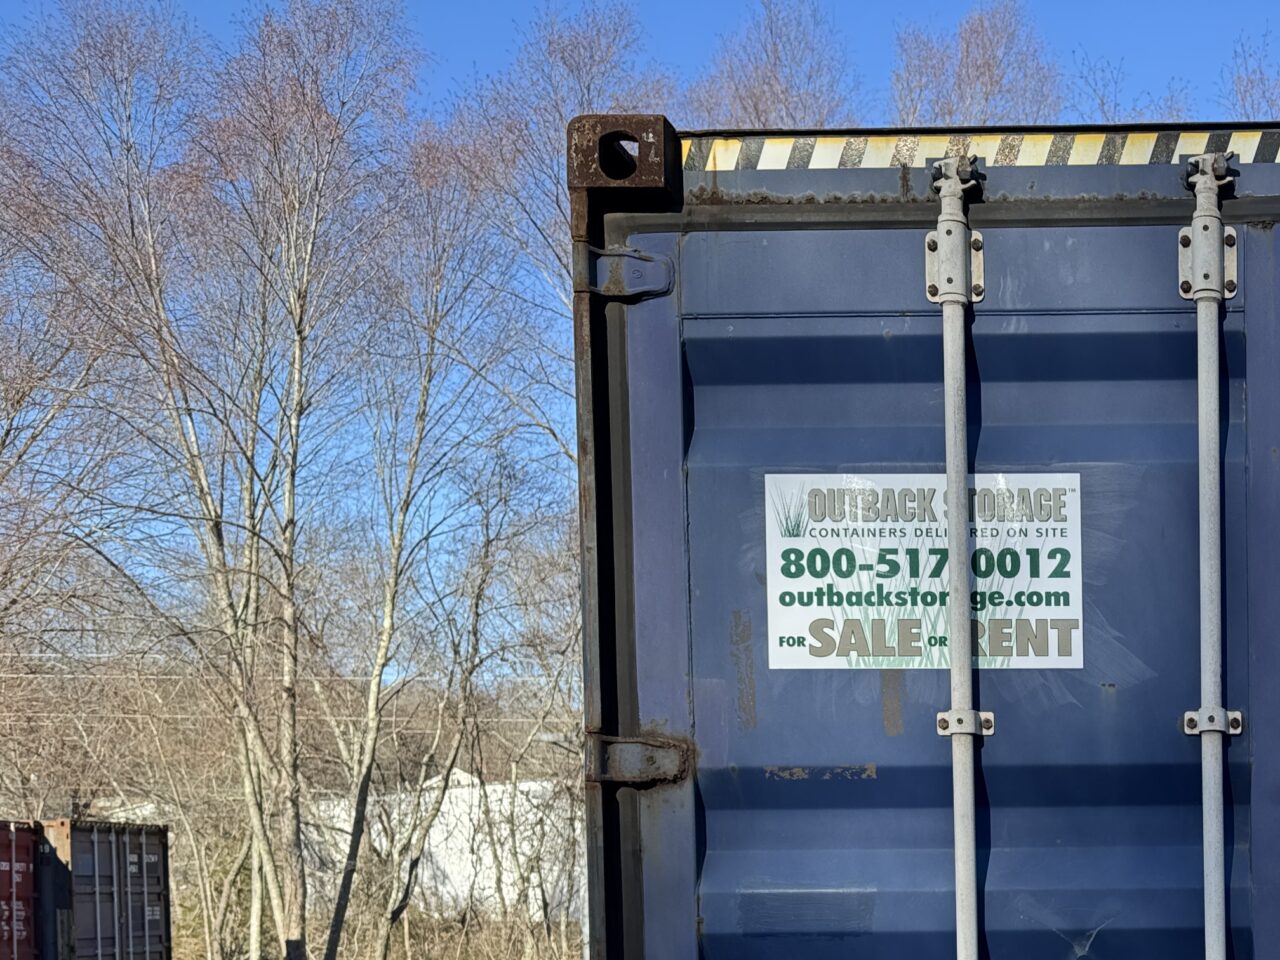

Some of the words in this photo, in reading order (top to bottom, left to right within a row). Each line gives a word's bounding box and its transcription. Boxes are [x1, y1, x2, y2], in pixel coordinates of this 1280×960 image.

[808, 488, 938, 522] OUTBACK
[943, 488, 1067, 522] TORAGE
[809, 527, 907, 538] CONTAINERS
[914, 527, 999, 538] DELIRED
[1007, 527, 1028, 538] ON
[1036, 527, 1068, 538] SITE
[781, 547, 1071, 579] 800-5170012
[779, 584, 1071, 611] outbackstorge.com
[779, 636, 806, 648] FOR
[809, 618, 922, 657] SALE
[928, 636, 948, 648] OR
[971, 618, 1079, 657] RENT
